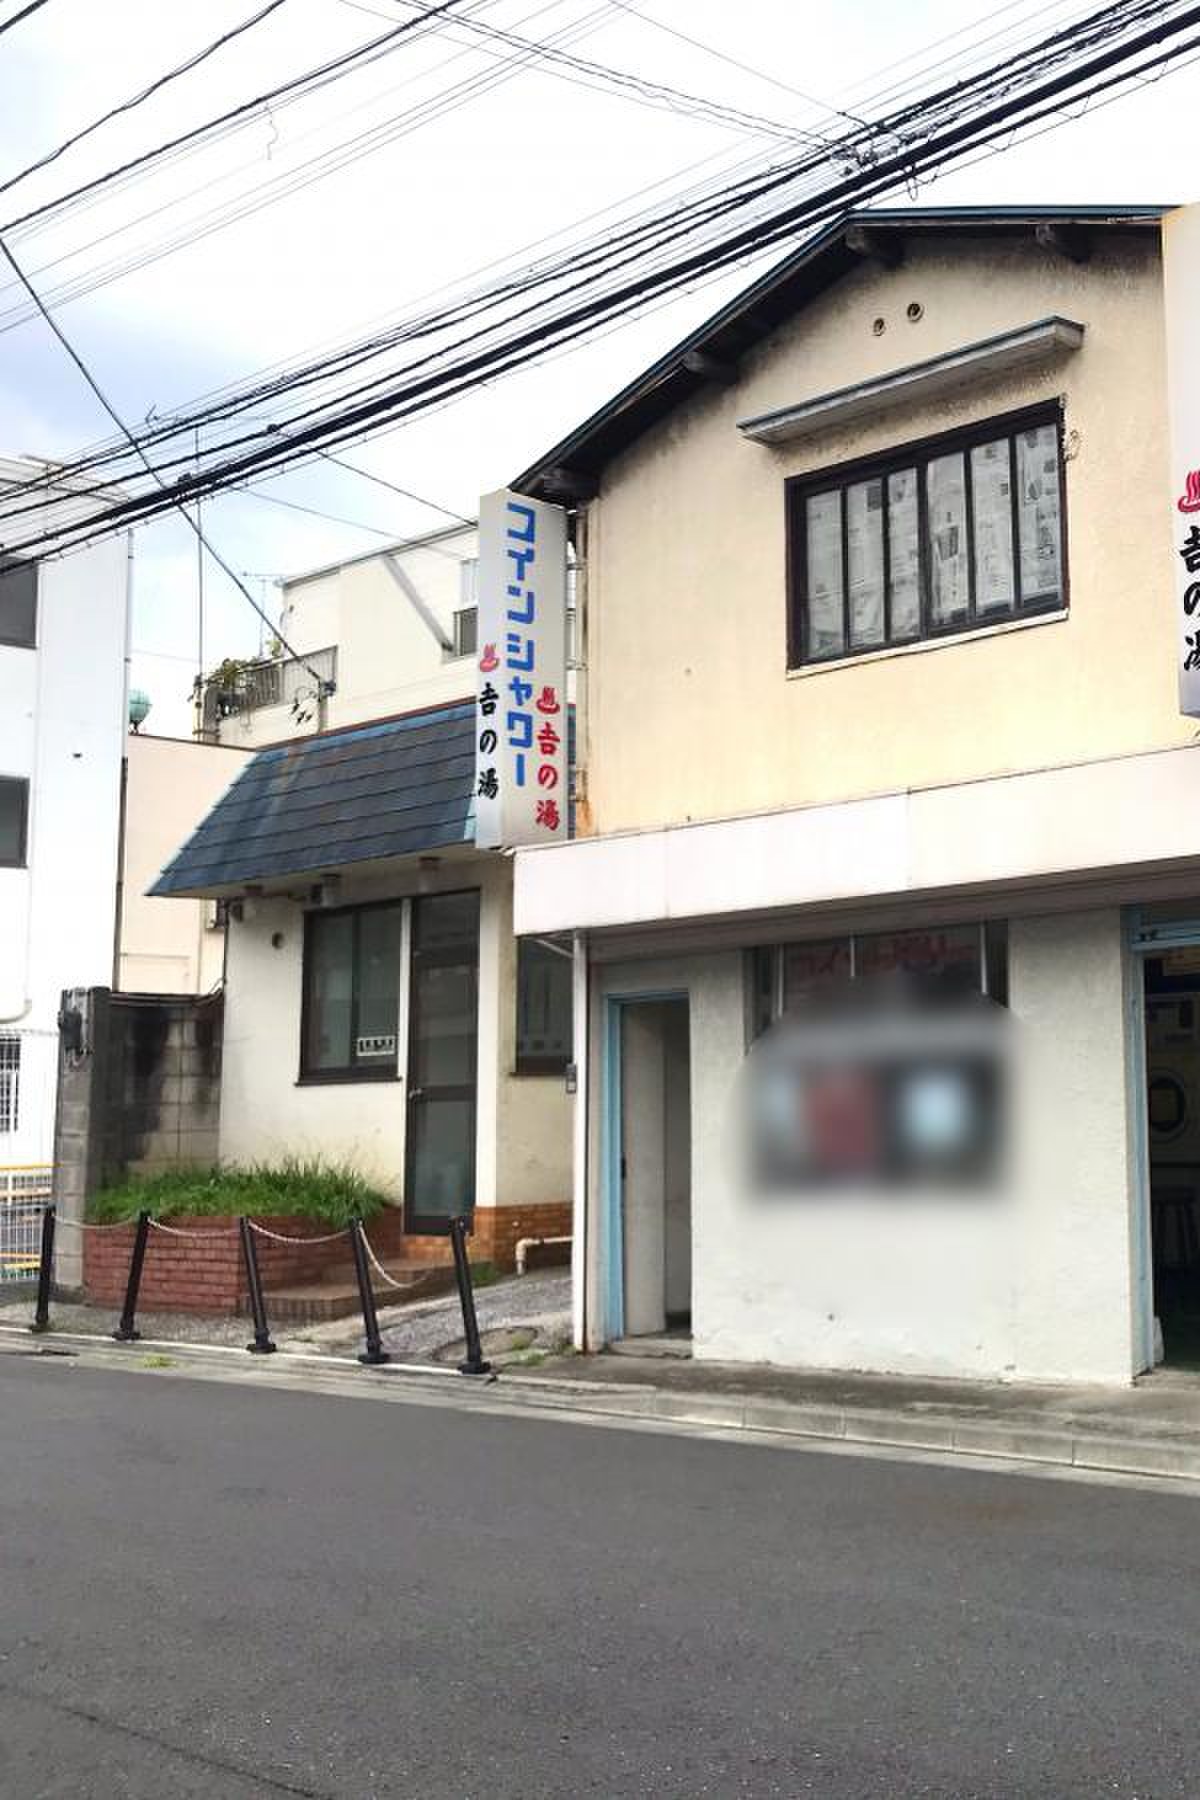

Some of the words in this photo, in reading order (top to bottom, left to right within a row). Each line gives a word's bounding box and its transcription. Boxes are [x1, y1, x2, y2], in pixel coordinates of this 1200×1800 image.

[506, 502, 536, 787] コインシャワー
